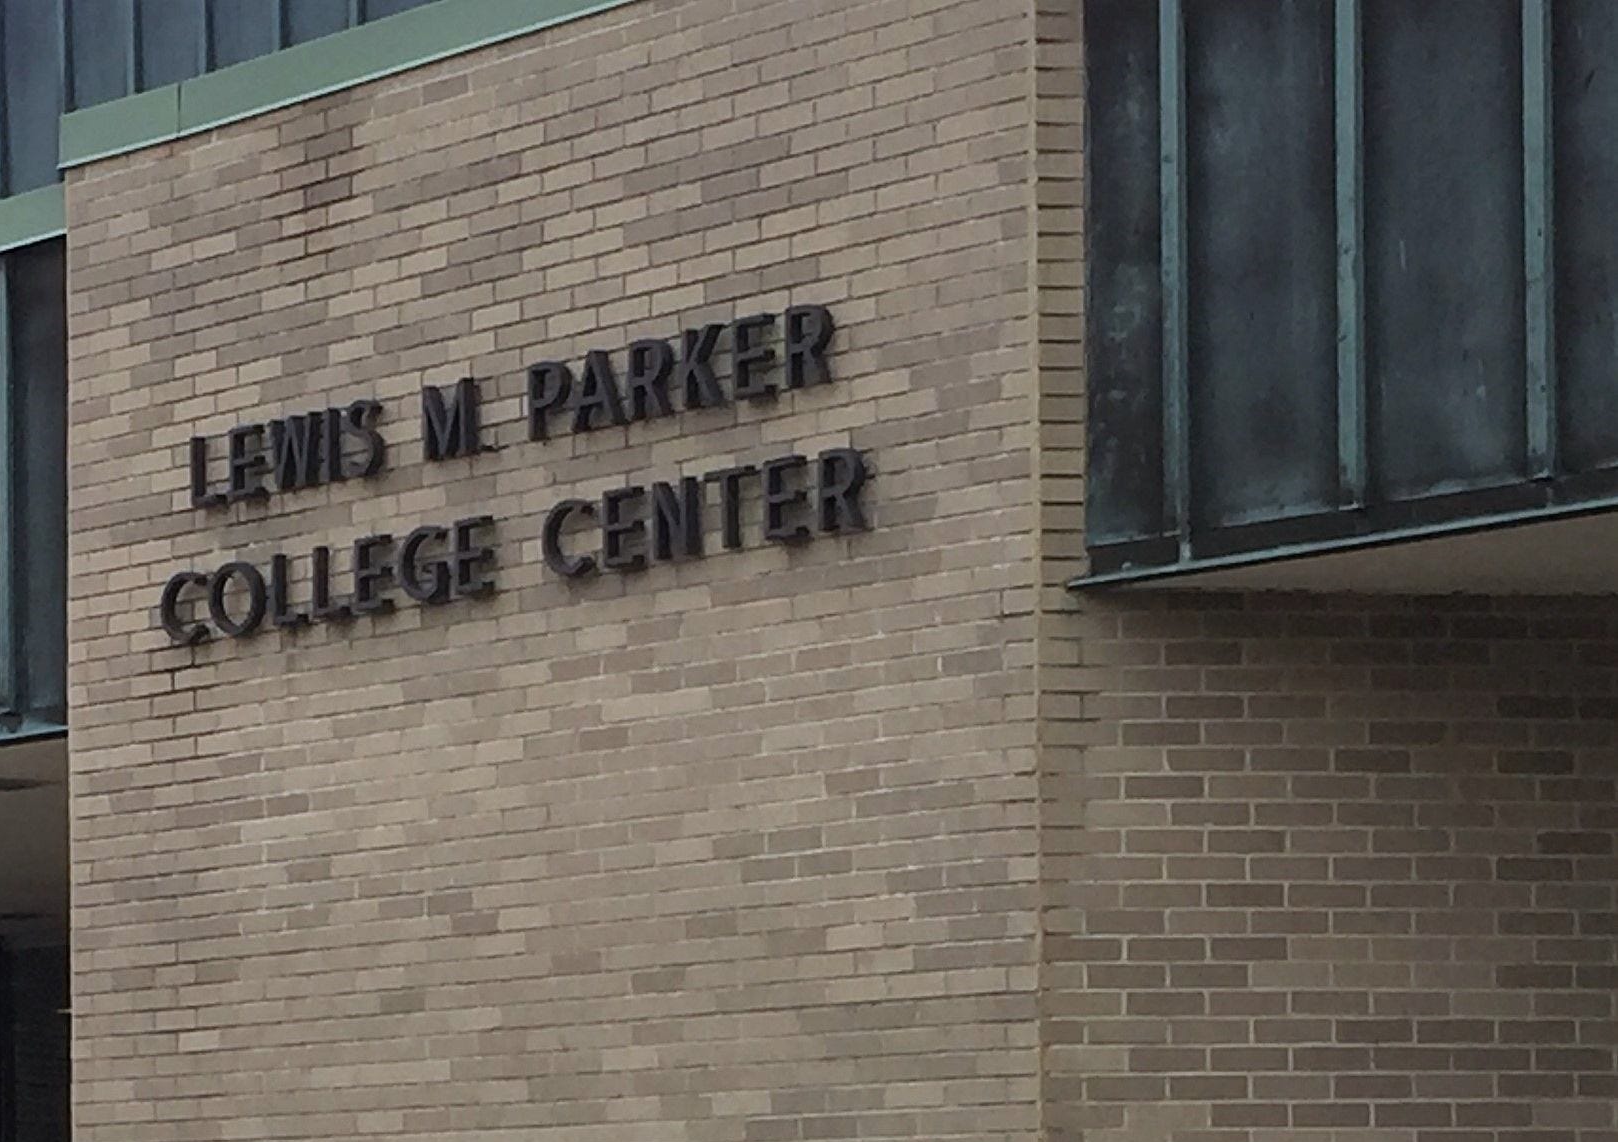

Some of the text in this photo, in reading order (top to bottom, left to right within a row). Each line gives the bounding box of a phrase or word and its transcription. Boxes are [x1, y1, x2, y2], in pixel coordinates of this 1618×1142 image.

[189, 400, 384, 507] LEWIS
[527, 304, 835, 441] PARKER
[161, 447, 873, 644] COLLEGE CENTER
